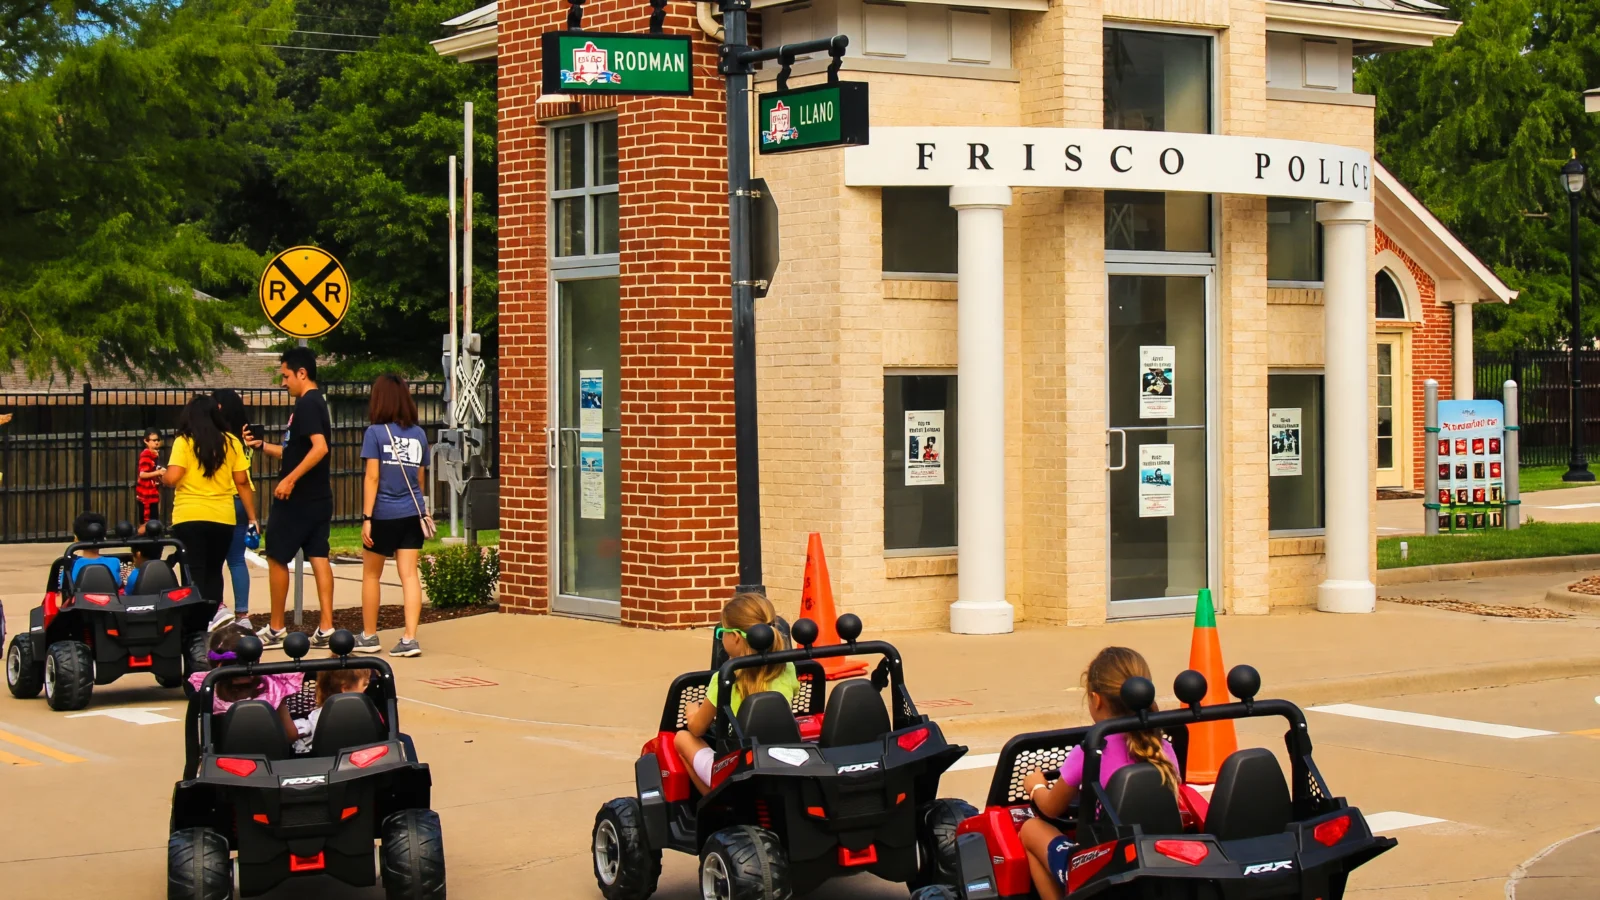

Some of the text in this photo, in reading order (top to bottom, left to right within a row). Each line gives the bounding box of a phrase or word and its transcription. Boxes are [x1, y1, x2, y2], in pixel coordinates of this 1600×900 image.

[614, 51, 685, 72] RODMAN
[800, 101, 834, 125] LLANO
[916, 142, 1369, 191] FRISCO POLICE
[269, 280, 341, 303] R R
